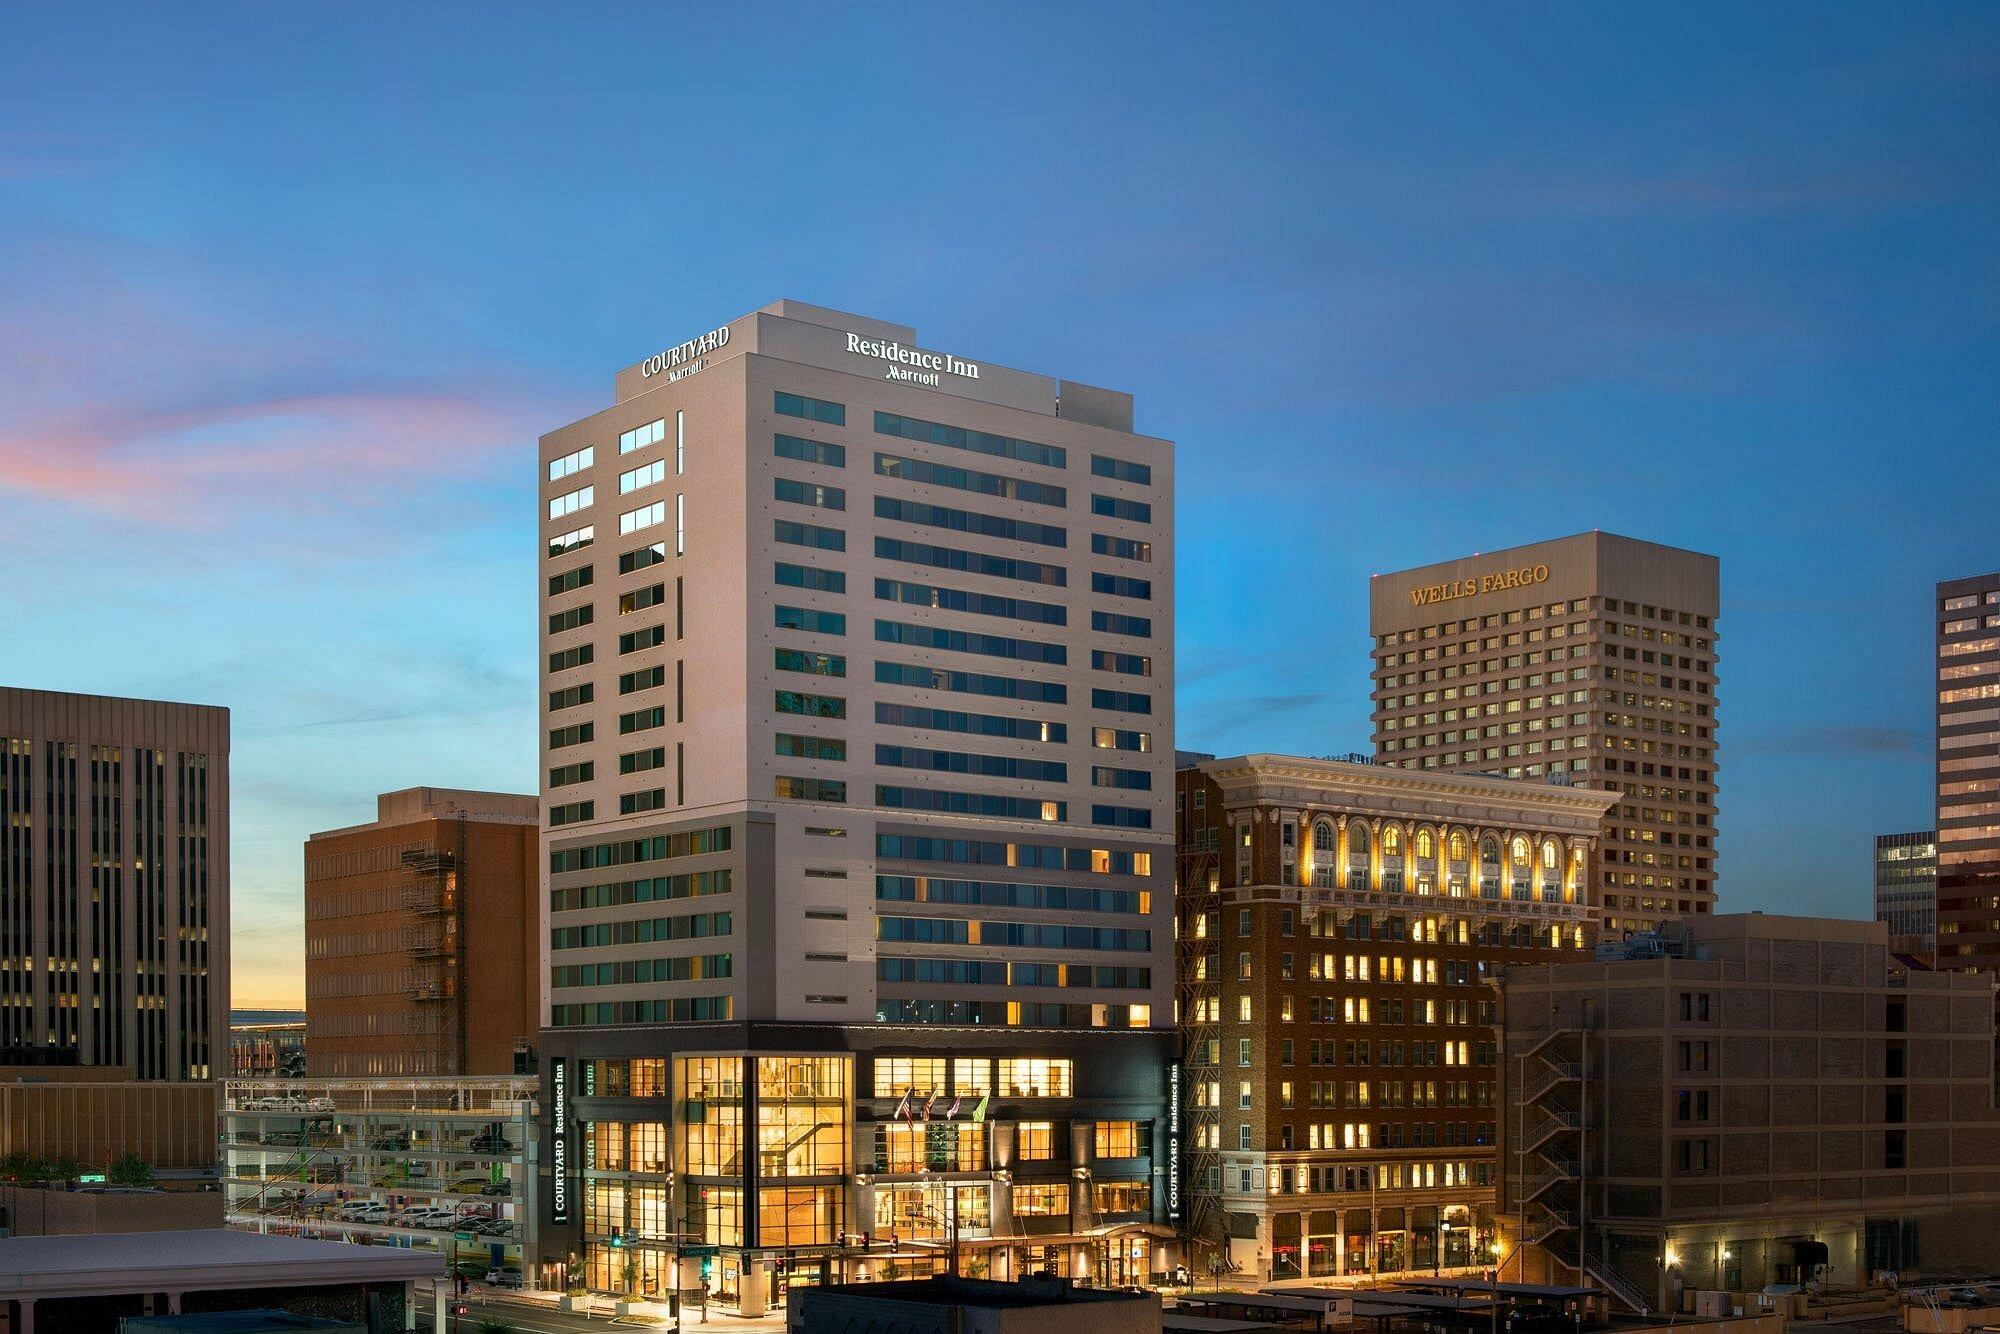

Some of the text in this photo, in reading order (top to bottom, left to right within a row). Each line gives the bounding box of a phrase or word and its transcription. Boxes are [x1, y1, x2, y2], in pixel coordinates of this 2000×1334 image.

[642, 326, 730, 378] COURTYARD
[669, 359, 704, 383] Marriott
[846, 332, 980, 379] Residence Inn
[885, 364, 939, 387] Marriott
[1411, 564, 1549, 606] WELLS FARGO
[554, 1064, 564, 1083] Inn
[1170, 1064, 1178, 1082] Inn
[555, 1083, 564, 1134] Residence
[1170, 1083, 1178, 1133] Residence
[555, 1139, 564, 1211] COURTYARD
[1170, 1138, 1178, 1208] COURTYARD
